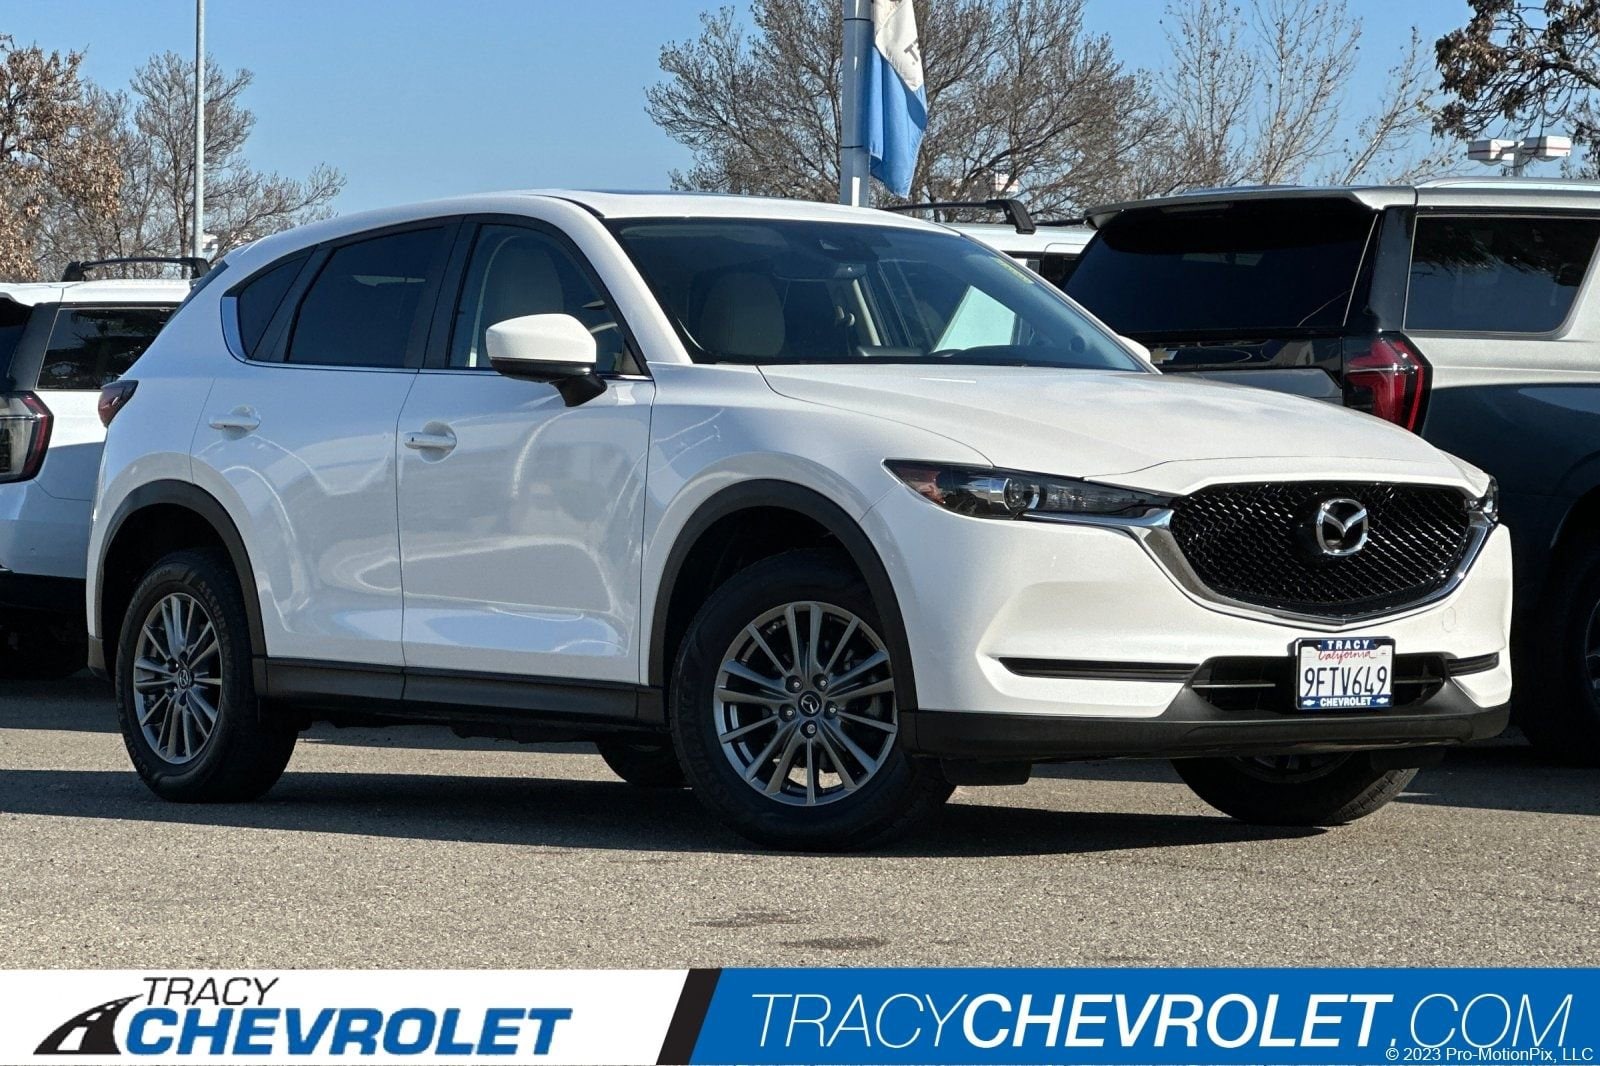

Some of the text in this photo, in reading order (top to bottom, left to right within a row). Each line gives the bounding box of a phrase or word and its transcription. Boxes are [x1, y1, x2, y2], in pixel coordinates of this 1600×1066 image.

[1327, 640, 1370, 650] TRACY
[1318, 650, 1376, 665] California
[1304, 666, 1387, 697] 9FTV649
[1320, 697, 1372, 707] CHEVROLET
